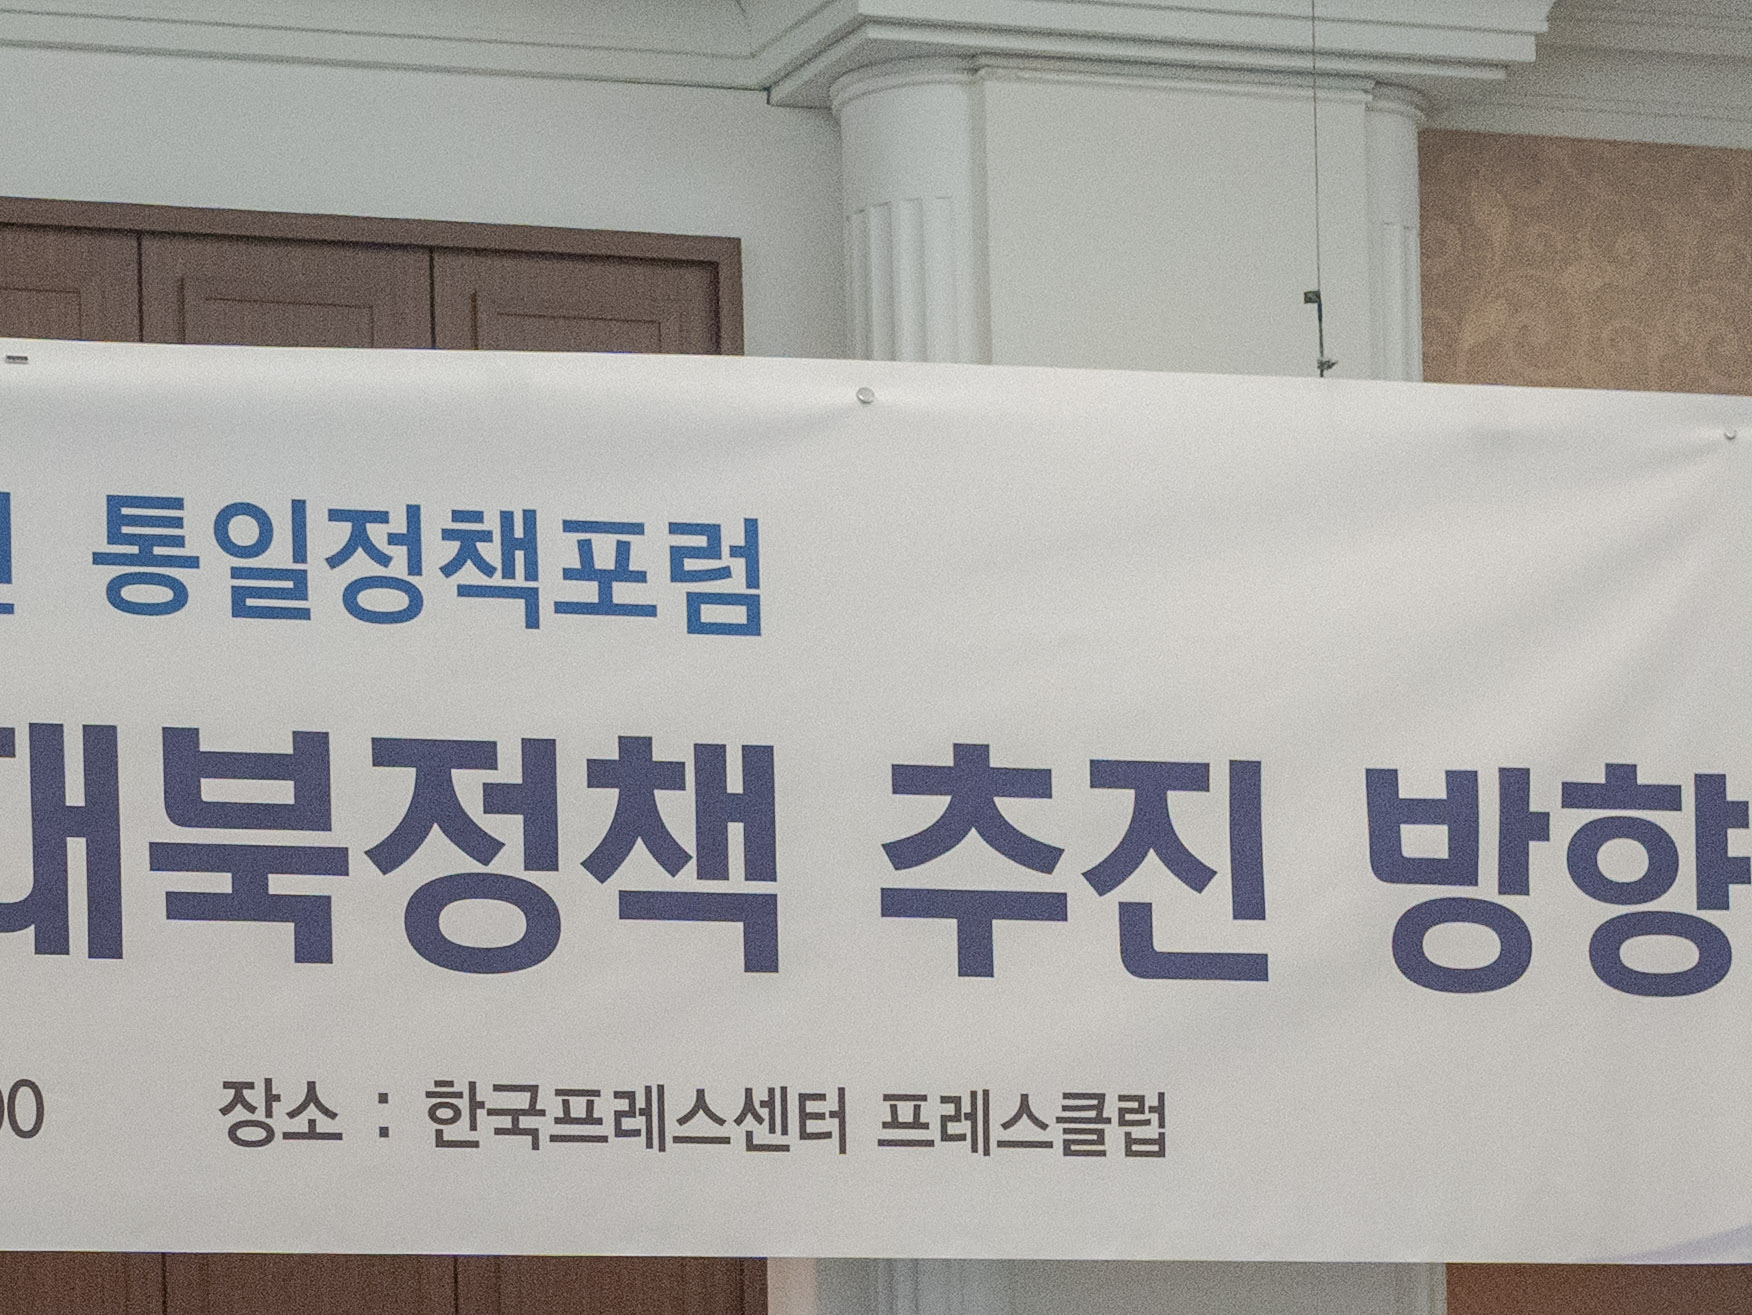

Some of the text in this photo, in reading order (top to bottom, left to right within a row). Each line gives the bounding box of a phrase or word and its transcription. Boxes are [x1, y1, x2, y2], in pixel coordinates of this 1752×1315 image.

[91, 494, 762, 637] 통일정책포럼
[879, 742, 1270, 982] 추진
[1365, 762, 1752, 998] 방향
[218, 1077, 344, 1149] 장소
[424, 1079, 847, 1155] 한국프레스센터
[876, 1088, 1167, 1159] 프레스클럽
